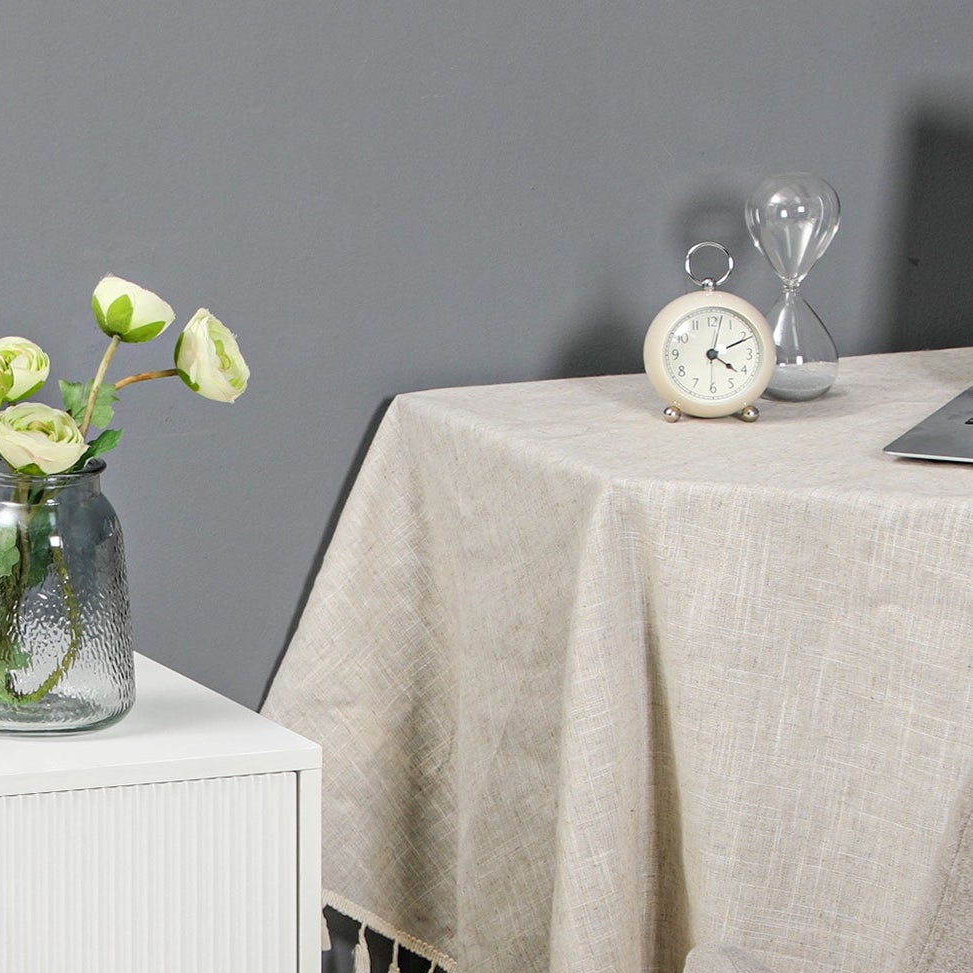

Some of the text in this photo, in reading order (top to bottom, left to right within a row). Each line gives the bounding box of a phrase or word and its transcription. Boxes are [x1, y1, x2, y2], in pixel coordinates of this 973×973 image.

[692, 320, 699, 330] 11
[707, 316, 718, 327] 12
[728, 320, 732, 329] 1
[678, 333, 689, 344] 10
[672, 349, 679, 360] 9
[747, 348, 753, 360] 3
[678, 366, 686, 377] 8
[741, 365, 747, 375] 4
[693, 378, 699, 388] 7
[710, 382, 717, 393] 6
[728, 378, 734, 388] 5
